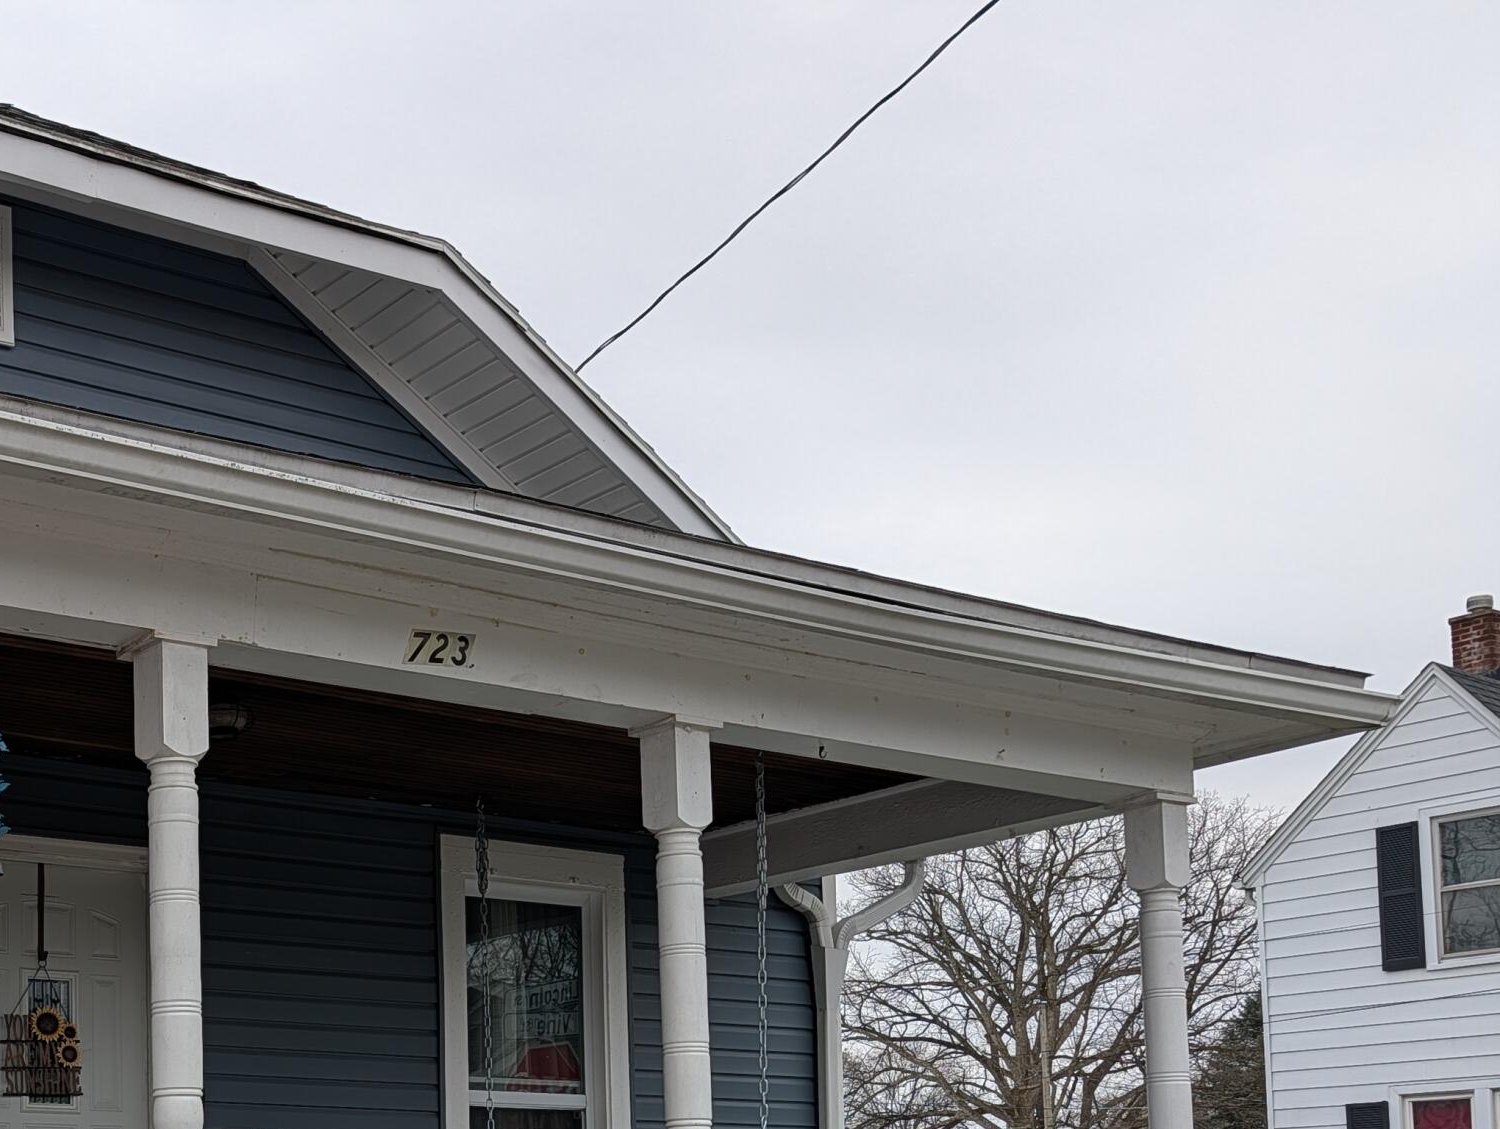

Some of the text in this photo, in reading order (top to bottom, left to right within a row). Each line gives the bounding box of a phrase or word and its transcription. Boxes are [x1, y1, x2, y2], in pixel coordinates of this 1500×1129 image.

[408, 632, 469, 666] 723
[4, 1042, 36, 1067] ARE
[5, 1069, 82, 1094] SUNSHINE
